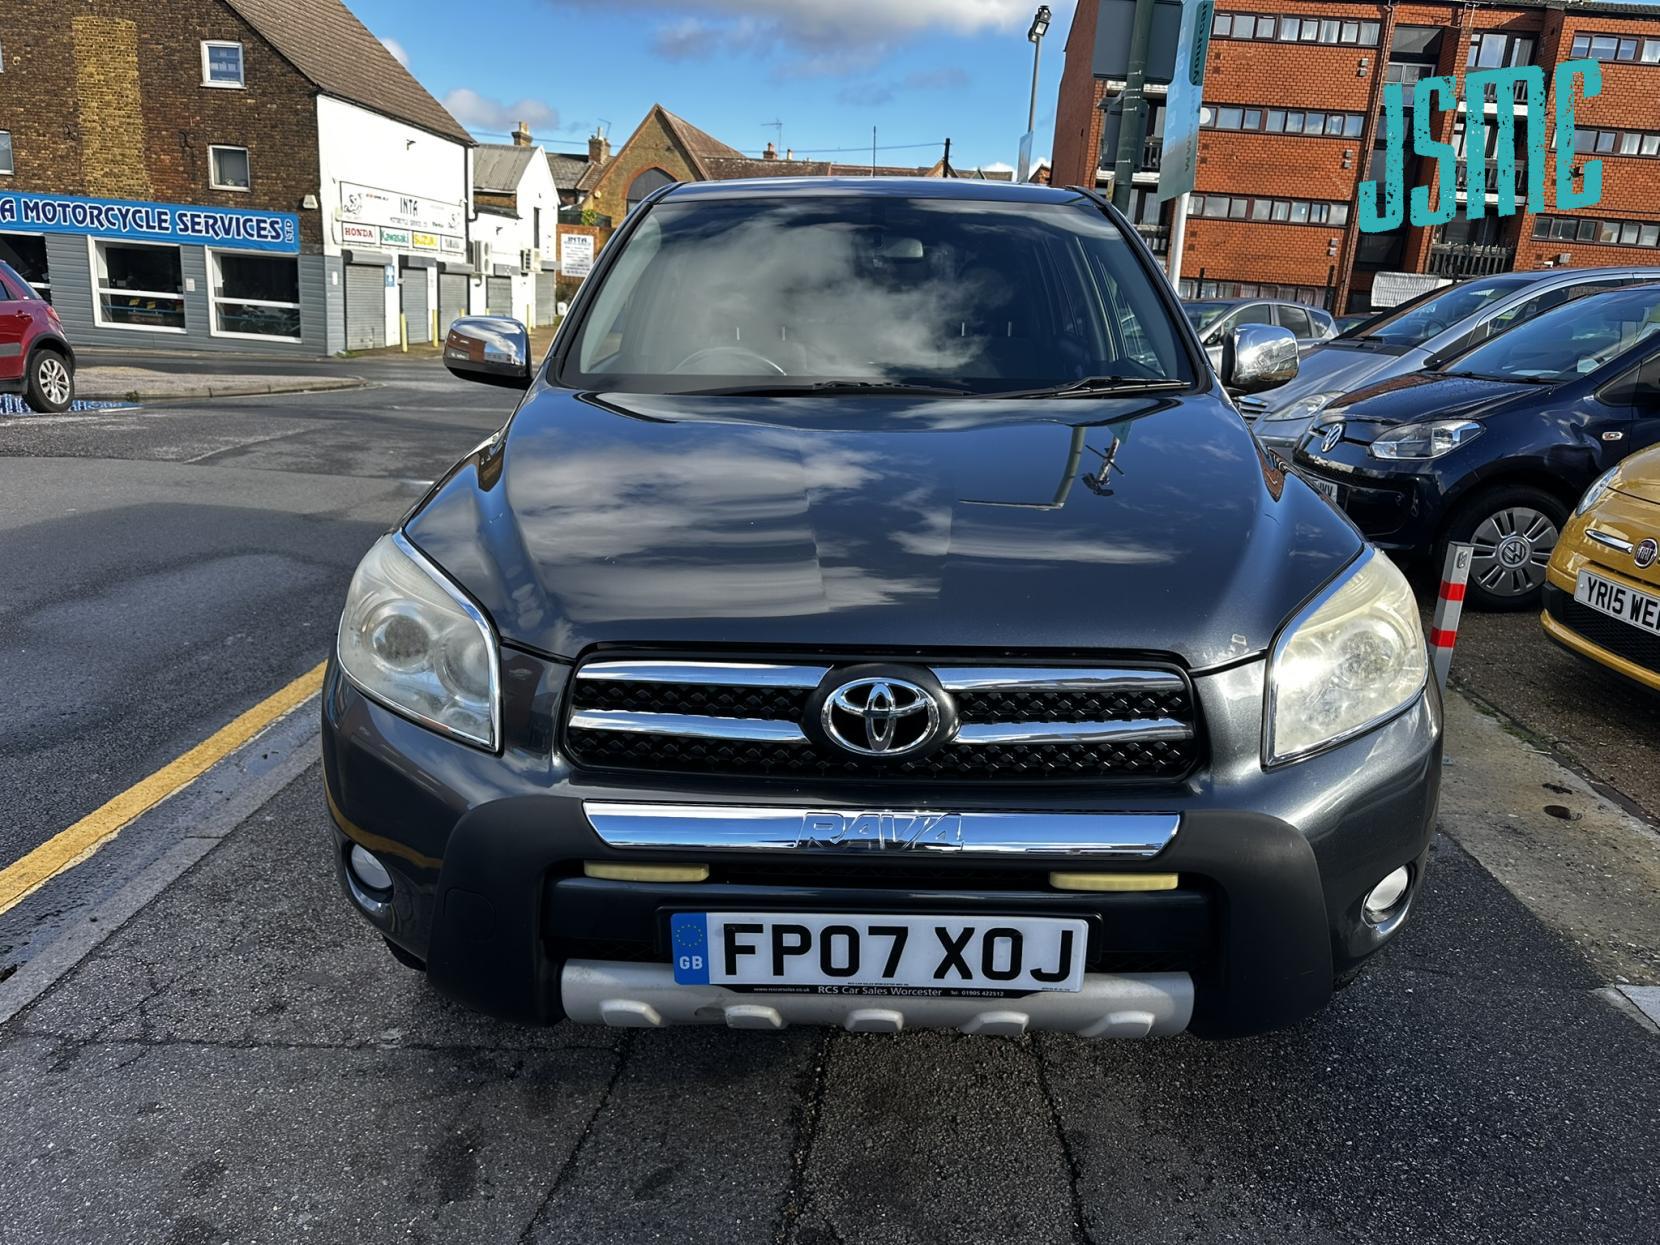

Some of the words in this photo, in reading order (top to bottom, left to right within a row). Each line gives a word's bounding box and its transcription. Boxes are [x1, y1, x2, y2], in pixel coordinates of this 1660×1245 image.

[400, 197, 418, 216] INTA
[22, 199, 170, 232] MOTORCYCLE
[177, 211, 282, 242] SERVICES
[284, 219, 294, 242] LTD
[345, 228, 373, 238] HONDA
[1588, 577, 1626, 615] YR15
[795, 812, 964, 852] RAV4
[678, 956, 702, 970] GB
[723, 923, 908, 978] FP07
[933, 926, 1074, 983] XOJ
[818, 986, 839, 995] RCS
[842, 986, 859, 995] Car
[862, 987, 888, 996] Sales
[891, 987, 942, 997] Worcester
